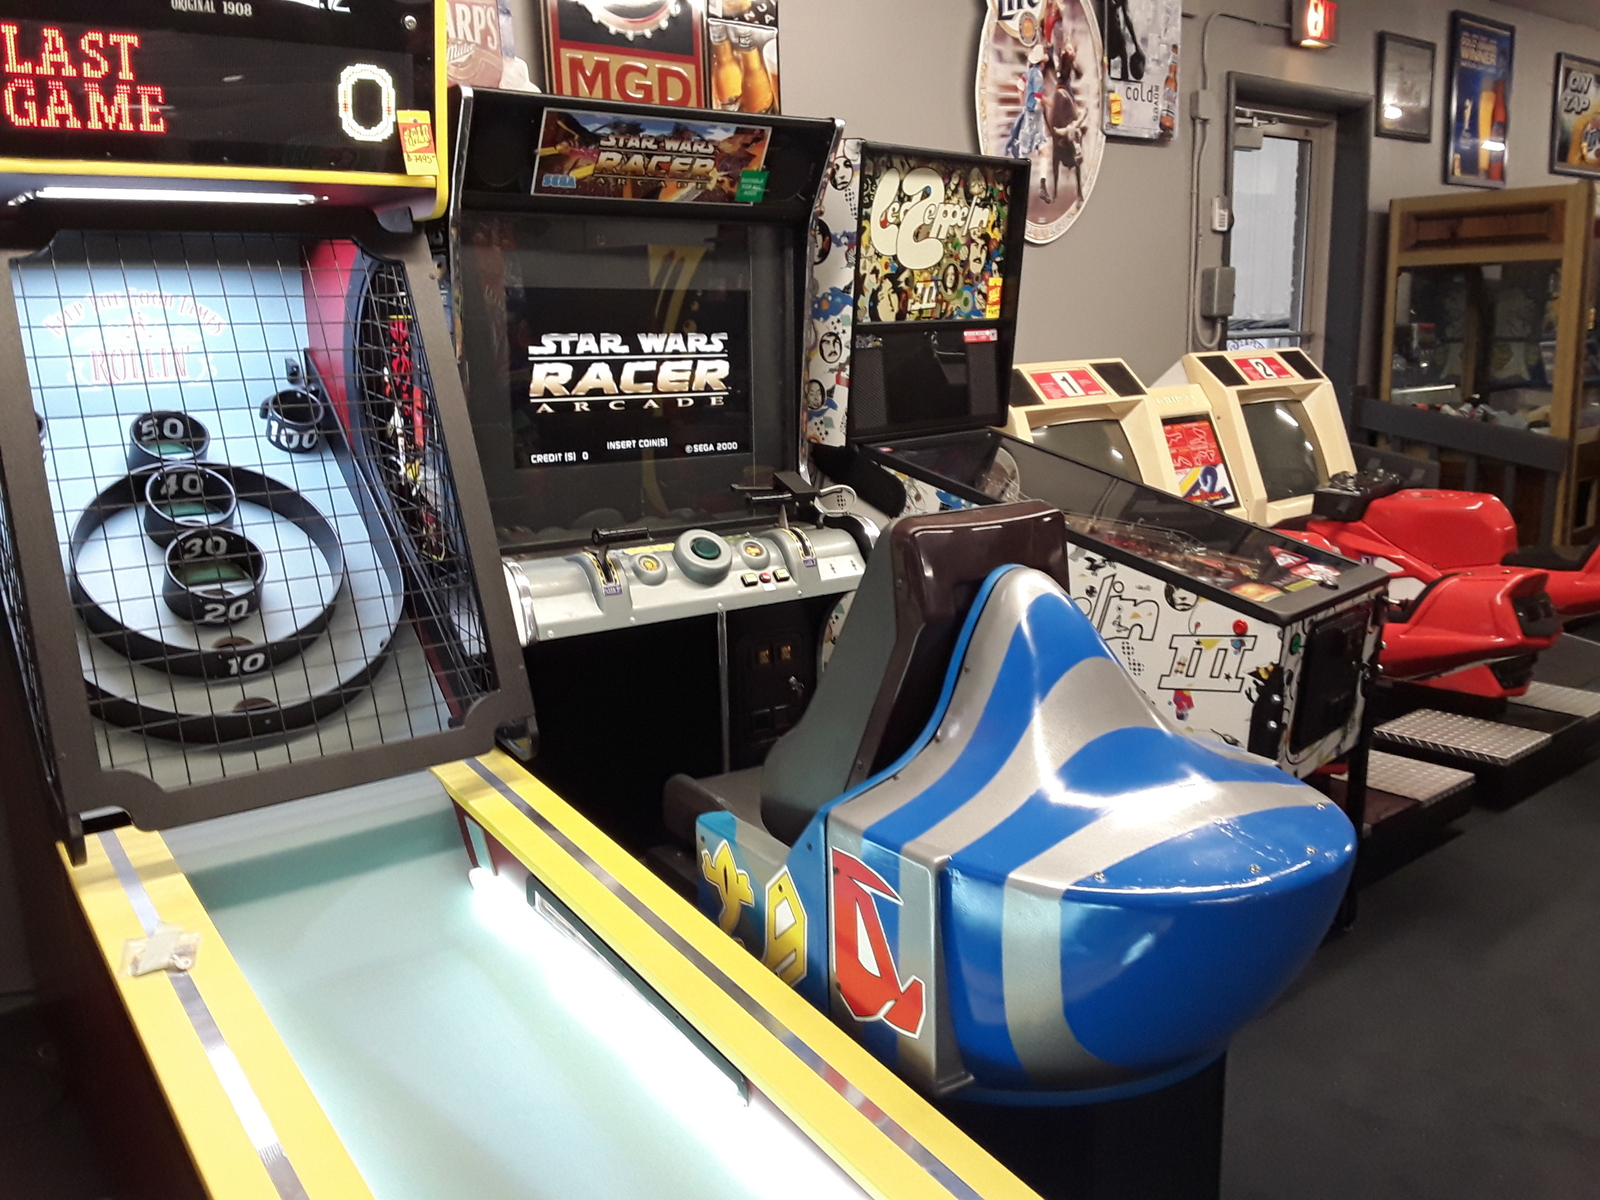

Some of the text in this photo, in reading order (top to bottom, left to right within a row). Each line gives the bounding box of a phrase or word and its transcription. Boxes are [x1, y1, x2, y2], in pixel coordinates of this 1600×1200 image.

[222, 1, 254, 17] 1908
[0, 23, 140, 81] LAST
[566, 51, 693, 106] MGD
[1569, 71, 1593, 94] ON
[338, 62, 396, 143] 0
[1125, 85, 1153, 102] cold
[3, 78, 167, 134] GAME
[600, 134, 716, 154] STAR WARS
[595, 151, 715, 178] RACER
[542, 175, 577, 188] SEGA
[527, 332, 728, 355] STAR WARS
[529, 359, 730, 397] RACER
[1254, 361, 1274, 377] 2
[1060, 376, 1078, 394] 1
[536, 396, 725, 414] ARCADE
[141, 417, 185, 441] 50
[270, 420, 318, 449] 100
[606, 440, 636, 450] INSERT
[716, 442, 738, 451] 2000
[530, 453, 563, 464] CREDIT
[582, 451, 589, 460] 0
[160, 473, 205, 496] 40
[184, 536, 228, 560] 30
[204, 599, 249, 623] 20
[228, 652, 266, 676] 10
